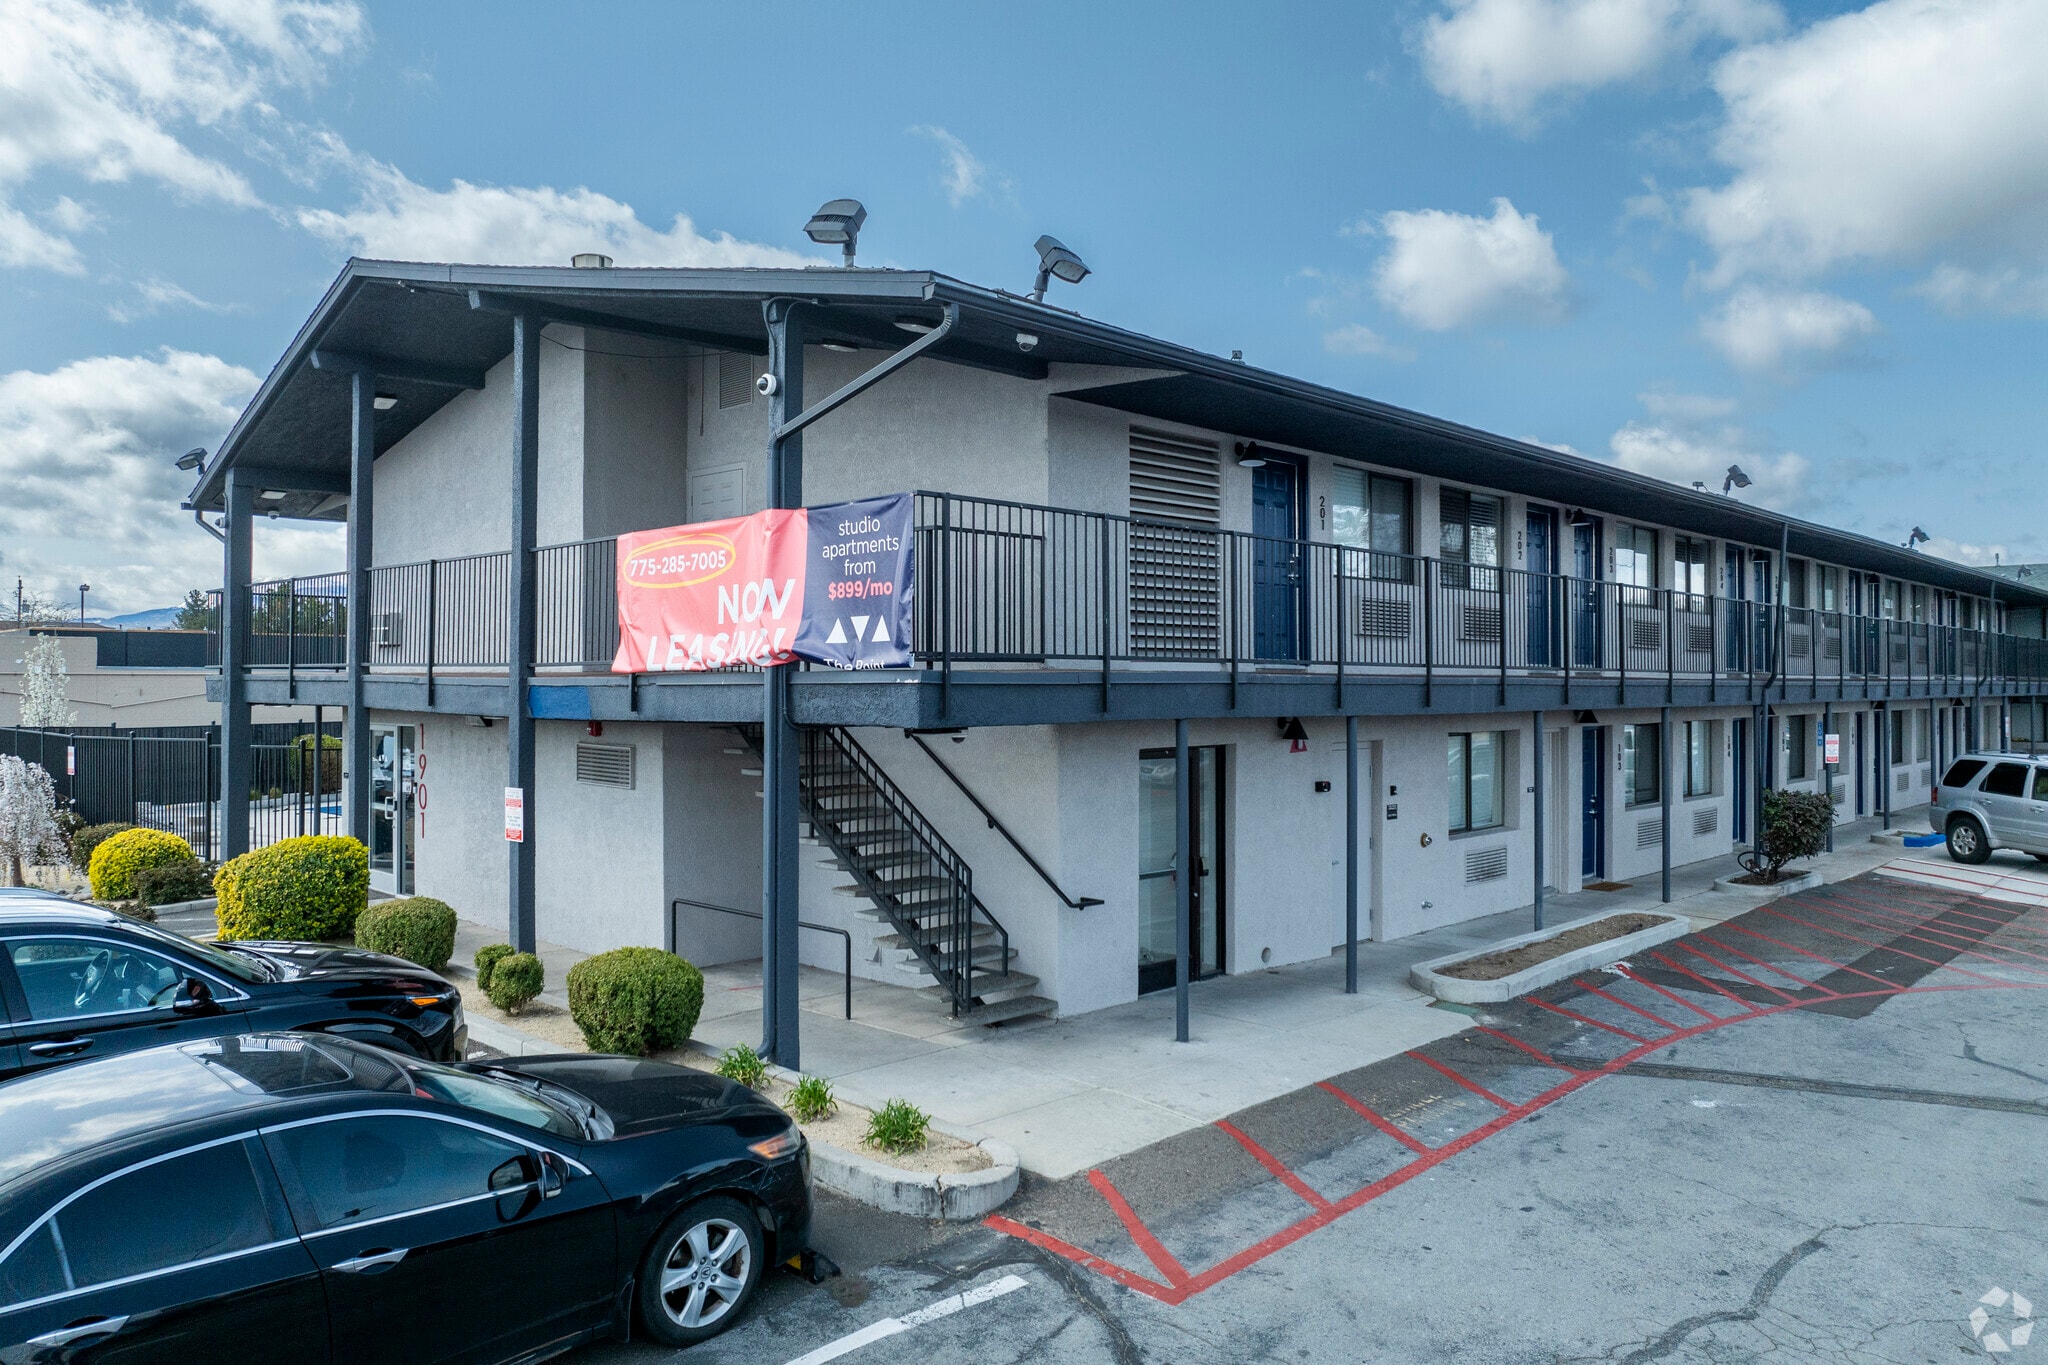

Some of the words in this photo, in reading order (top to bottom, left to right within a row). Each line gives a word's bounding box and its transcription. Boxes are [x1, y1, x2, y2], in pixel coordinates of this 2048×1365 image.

[838, 515, 881, 537] studio
[822, 534, 900, 561] apartments
[630, 549, 727, 577] 775-285-7005
[844, 558, 876, 576] from
[717, 578, 797, 625] NOW
[828, 577, 893, 601] $899/mo
[646, 627, 787, 672] LEASING!
[418, 723, 428, 839] 1901
